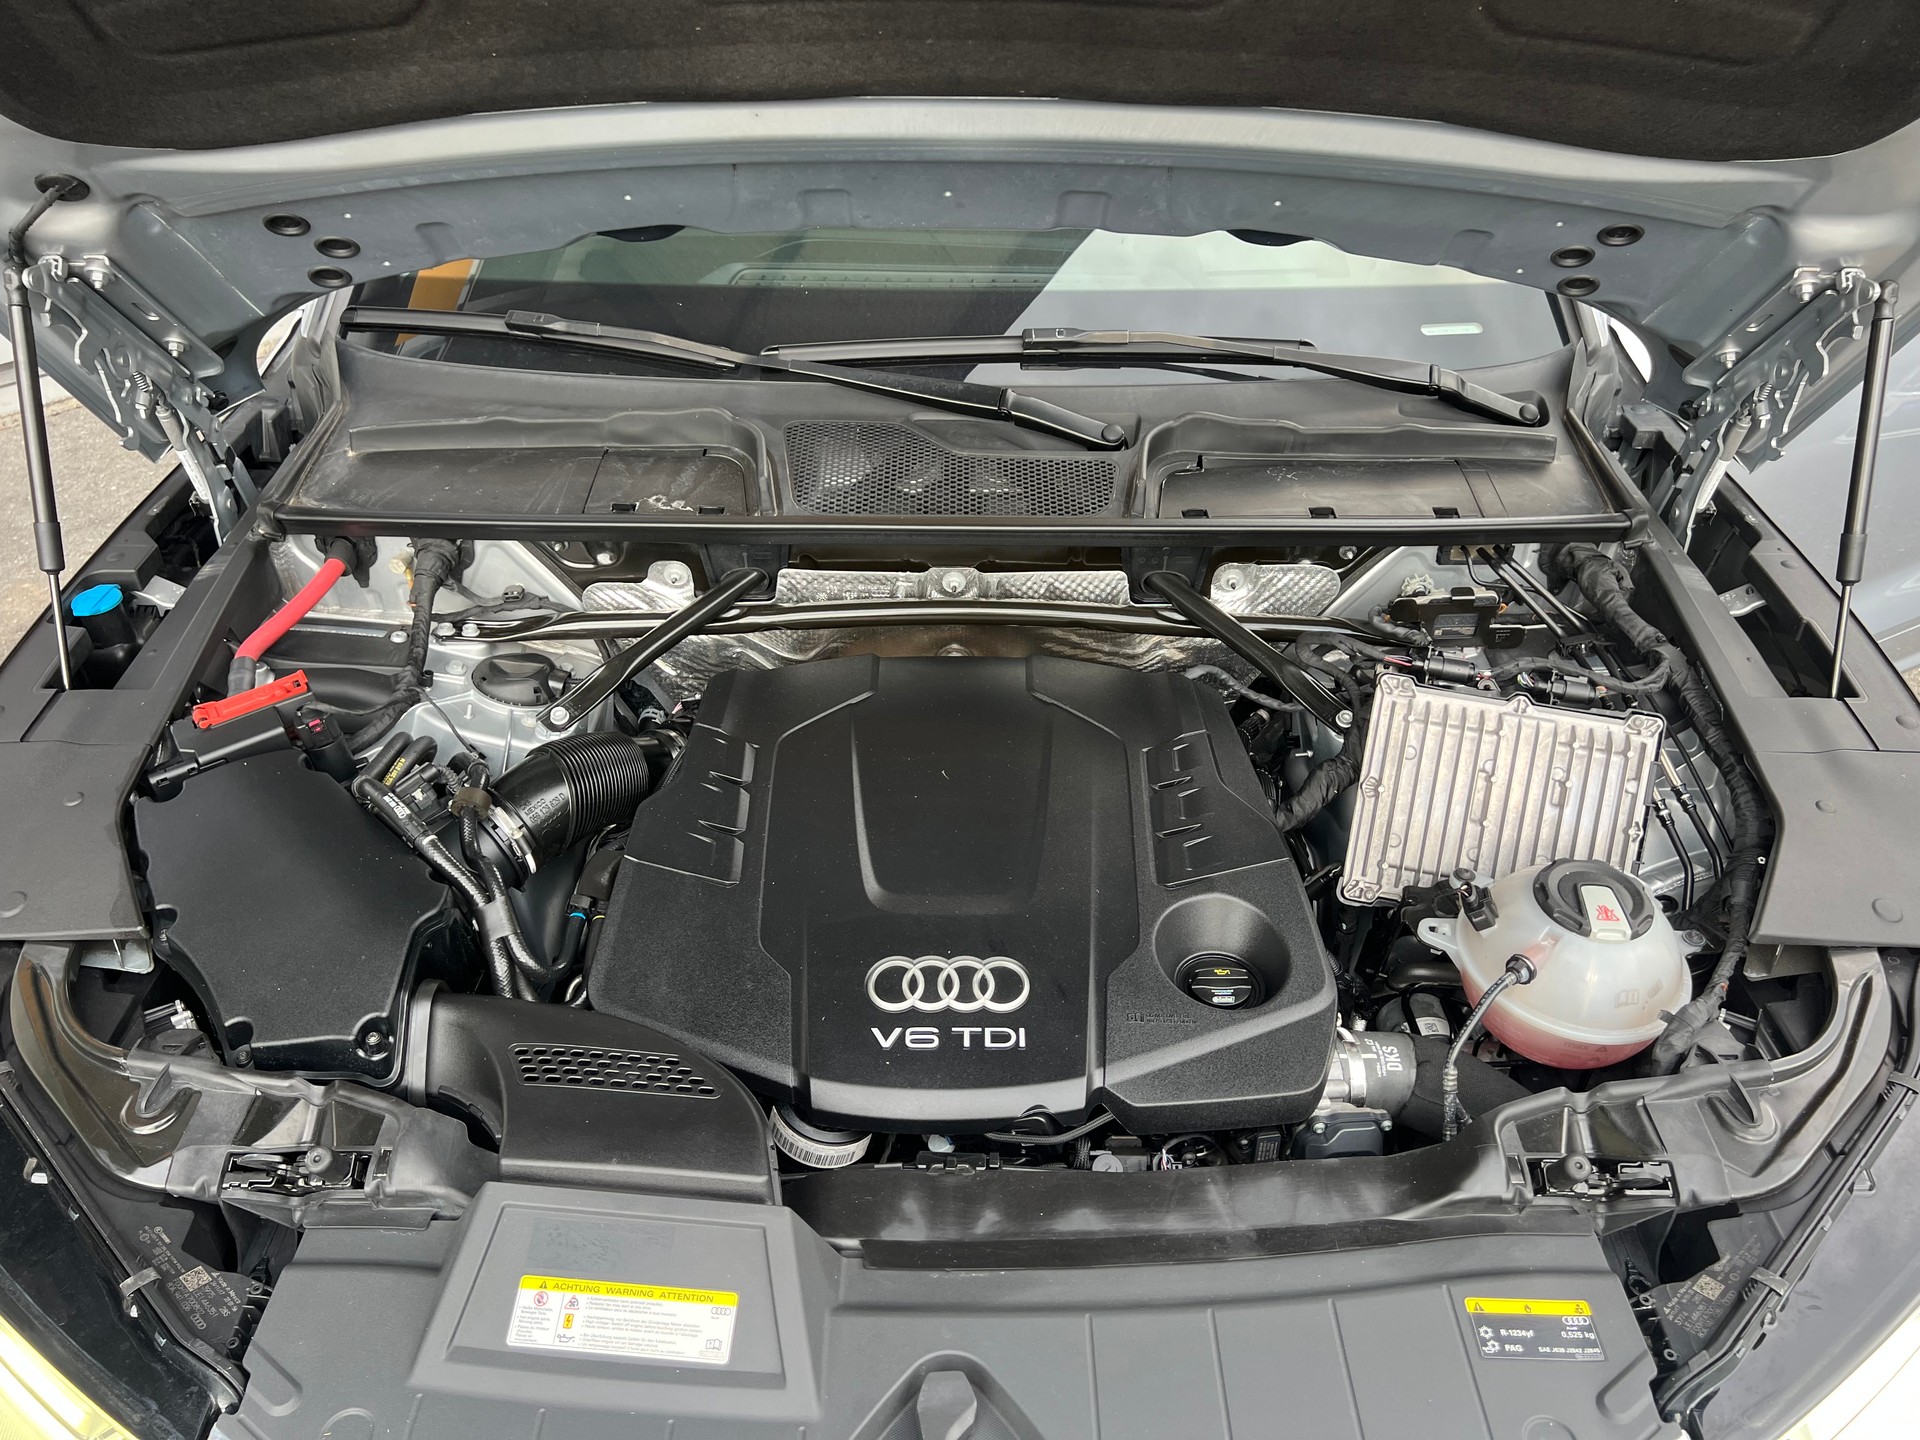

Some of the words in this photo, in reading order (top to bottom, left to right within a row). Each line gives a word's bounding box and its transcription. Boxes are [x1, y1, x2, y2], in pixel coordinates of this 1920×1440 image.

[524, 798, 546, 816] MEXICO
[870, 1027, 940, 1050] V6
[951, 1027, 1026, 1050] TDI
[1381, 1045, 1404, 1071] DKS
[552, 1282, 601, 1294] ACHTUNG
[605, 1287, 655, 1299] WARNING
[659, 1291, 714, 1304] ATTENTION
[1500, 1329, 1535, 1338] R-1234yf
[1561, 1331, 1583, 1340] 0,525
[1584, 1331, 1595, 1340] kg
[1504, 1344, 1523, 1352] PAG
